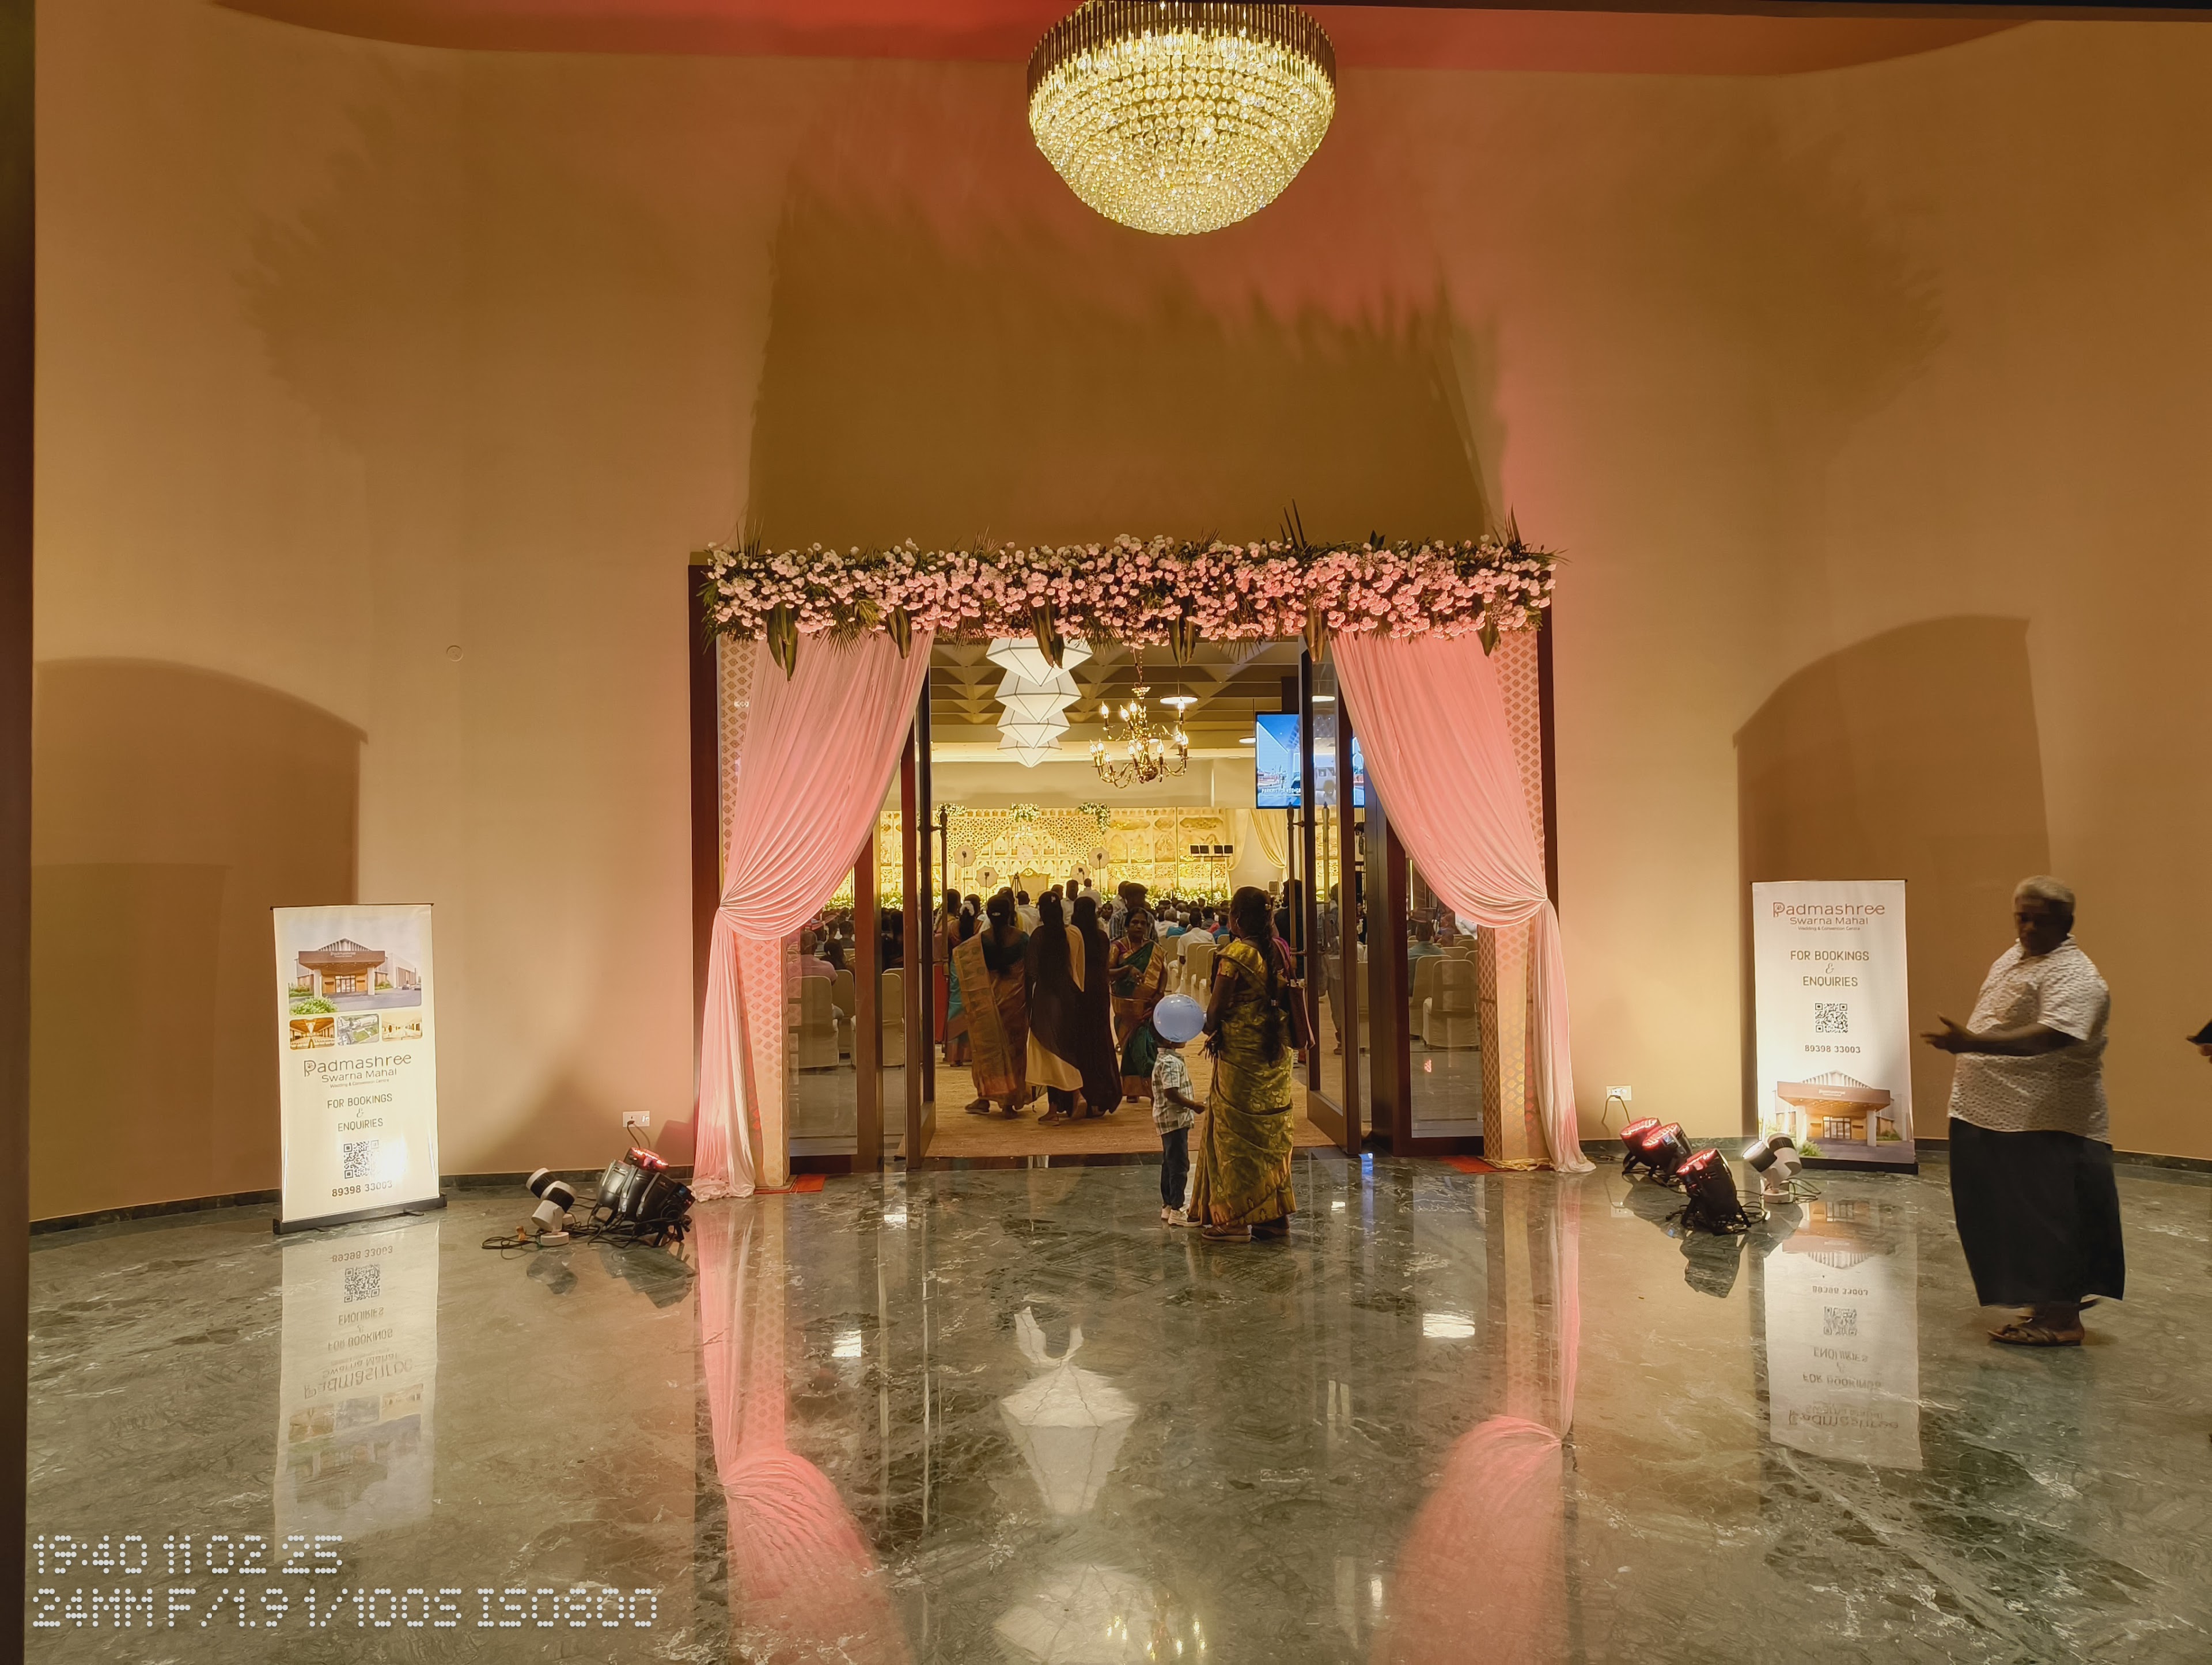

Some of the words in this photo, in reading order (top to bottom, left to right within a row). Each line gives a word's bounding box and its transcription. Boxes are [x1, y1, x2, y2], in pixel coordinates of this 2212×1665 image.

[1773, 902, 1885, 917] Padmashree
[1790, 917, 1832, 925] Swarna
[1835, 917, 1868, 925] Mahal
[1790, 950, 1810, 960] FOR
[1815, 951, 1869, 961] BOOKINGS
[1825, 963, 1834, 974] &
[1803, 976, 1858, 987] ENQUIRIES
[1834, 1045, 1861, 1053] 33003
[304, 1055, 411, 1077] Padmashree
[321, 1072, 362, 1083] Swarna
[366, 1068, 397, 1078] Mahal
[327, 1099, 344, 1109] FOR
[347, 1093, 392, 1106] BOOKINGS
[357, 1108, 364, 1117] &
[338, 1118, 383, 1132] ENQUIRIES
[332, 1185, 361, 1197] 89398
[365, 1180, 392, 1192] 33003
